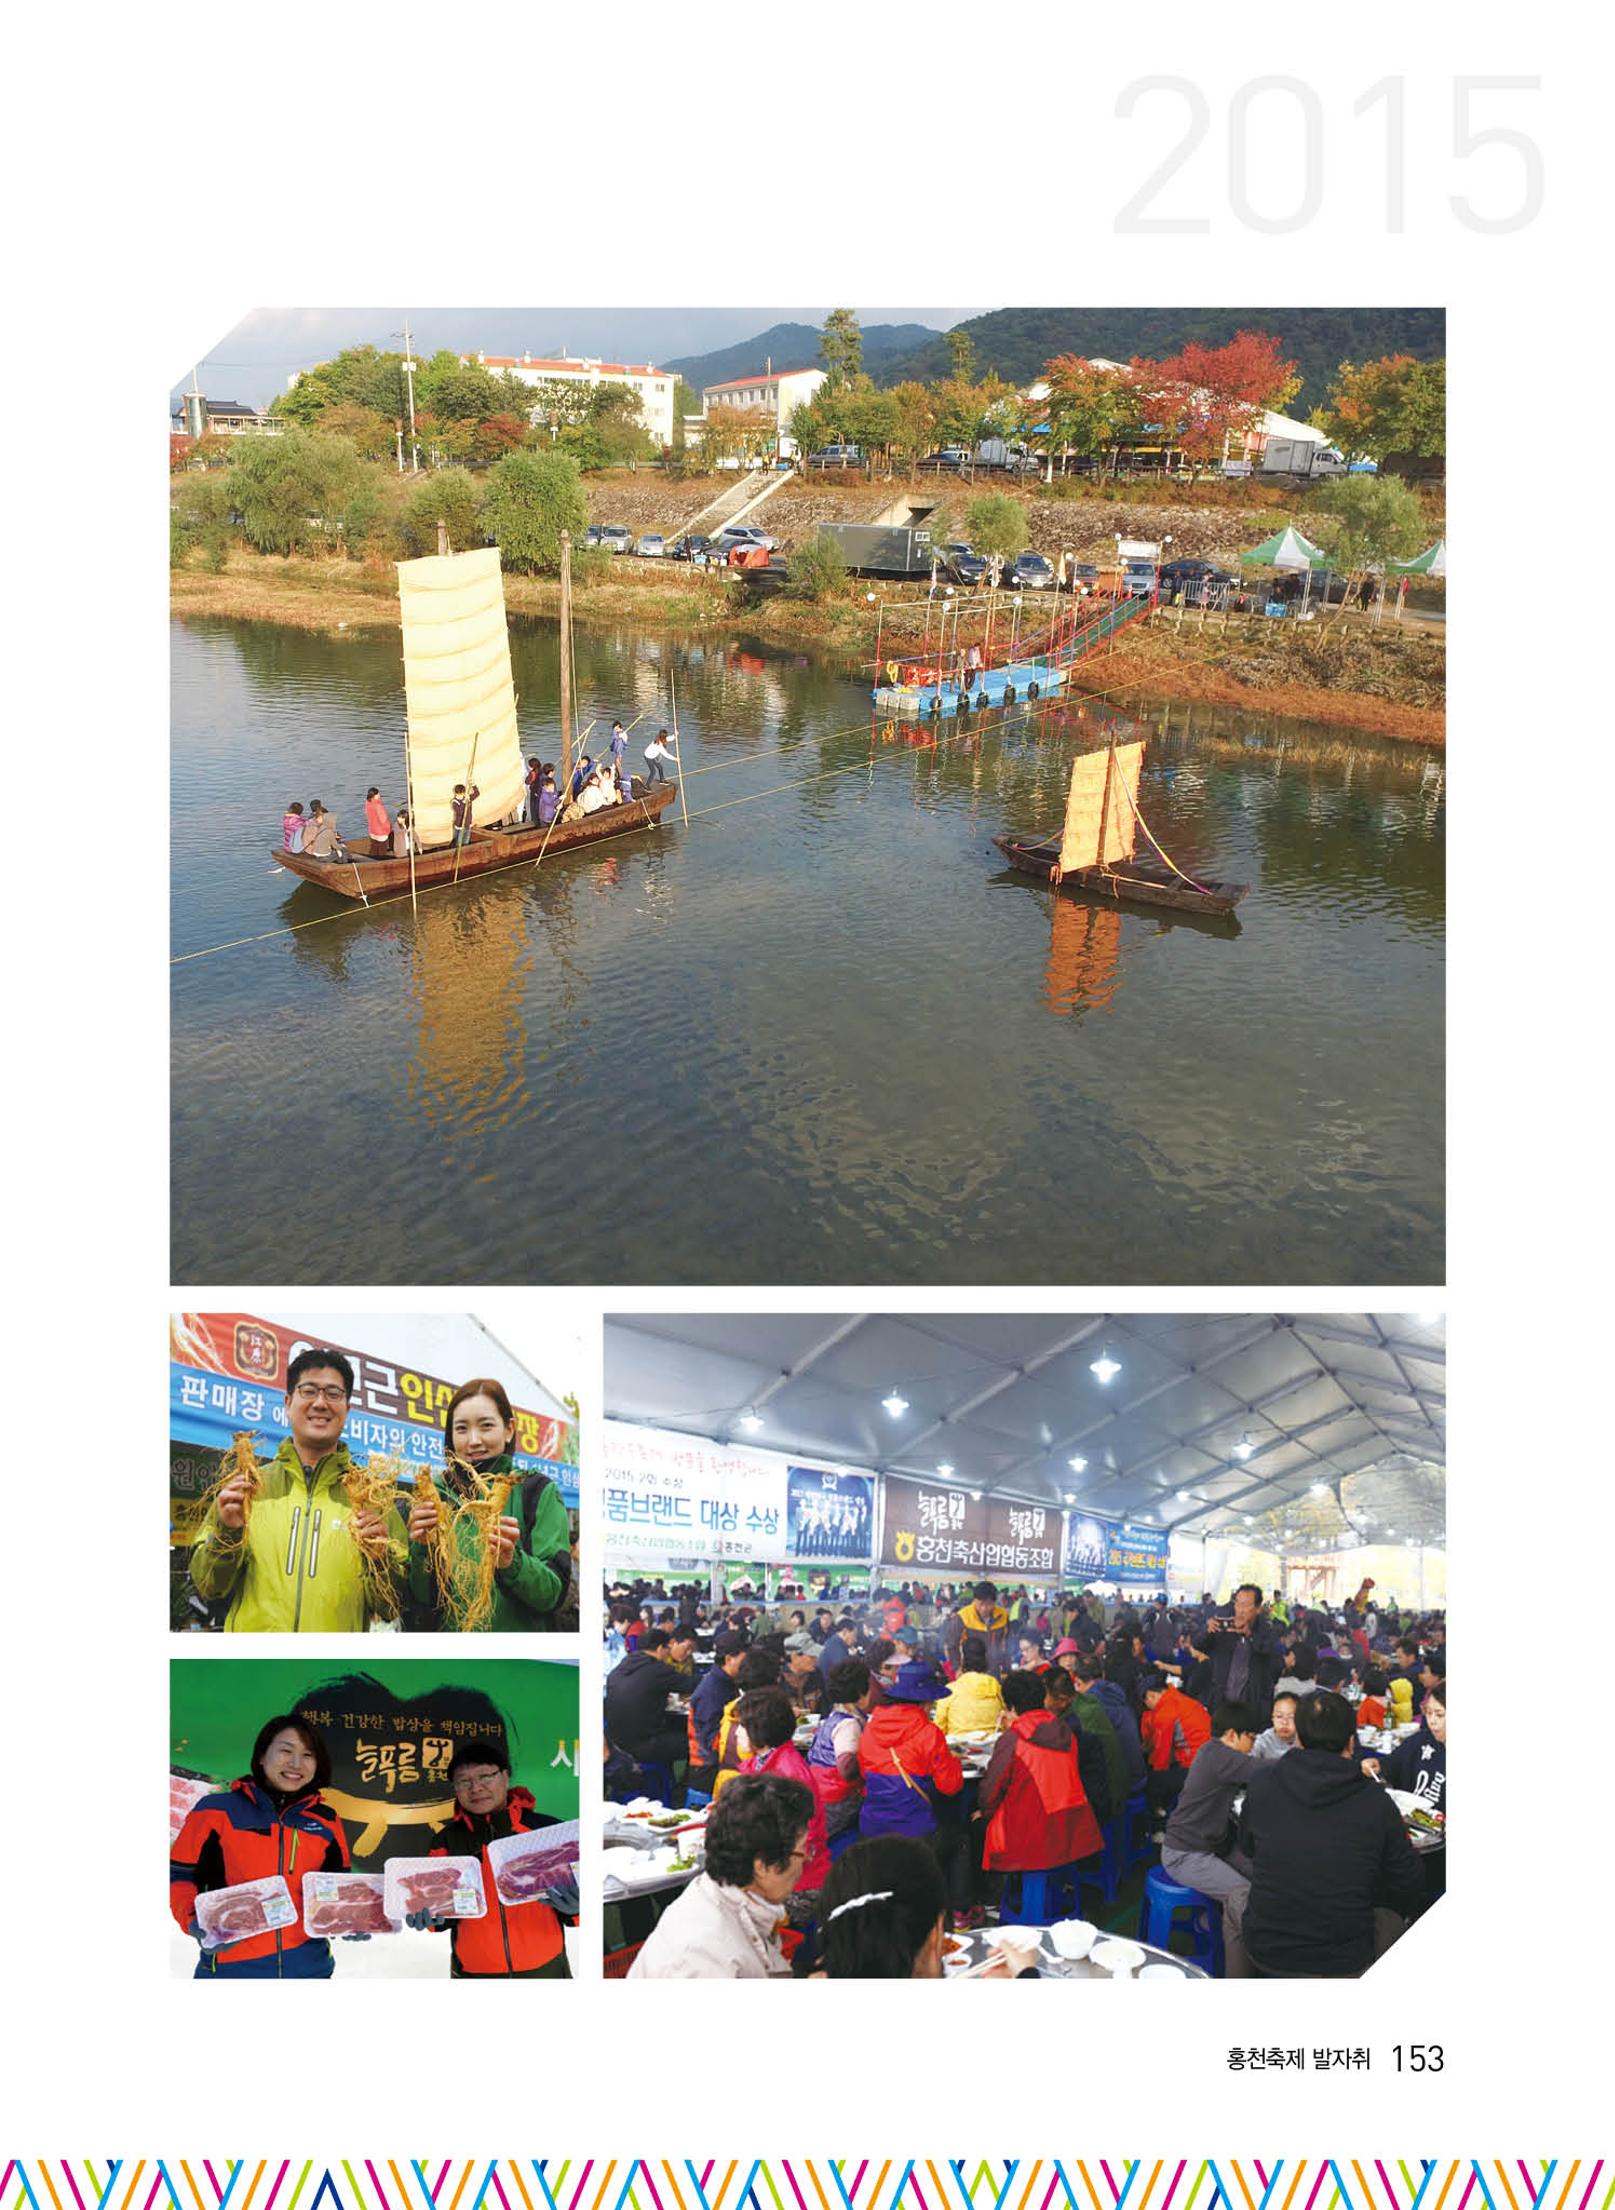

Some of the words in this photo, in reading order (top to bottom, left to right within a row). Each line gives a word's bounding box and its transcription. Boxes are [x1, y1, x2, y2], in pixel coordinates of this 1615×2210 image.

[180, 1374, 265, 1421] 판매장
[341, 1418, 406, 1453] 비자의
[603, 1487, 693, 1528] 품브랜드
[701, 1499, 740, 1532] 대상
[745, 1504, 780, 1535] 수상
[916, 1535, 1054, 1570] 홍천축산업협동조합
[341, 1713, 385, 1730] 건강한
[392, 1716, 434, 1734] 밥상을
[440, 1719, 502, 1737] 책임집니다
[355, 1737, 420, 1794] 늘푸름
